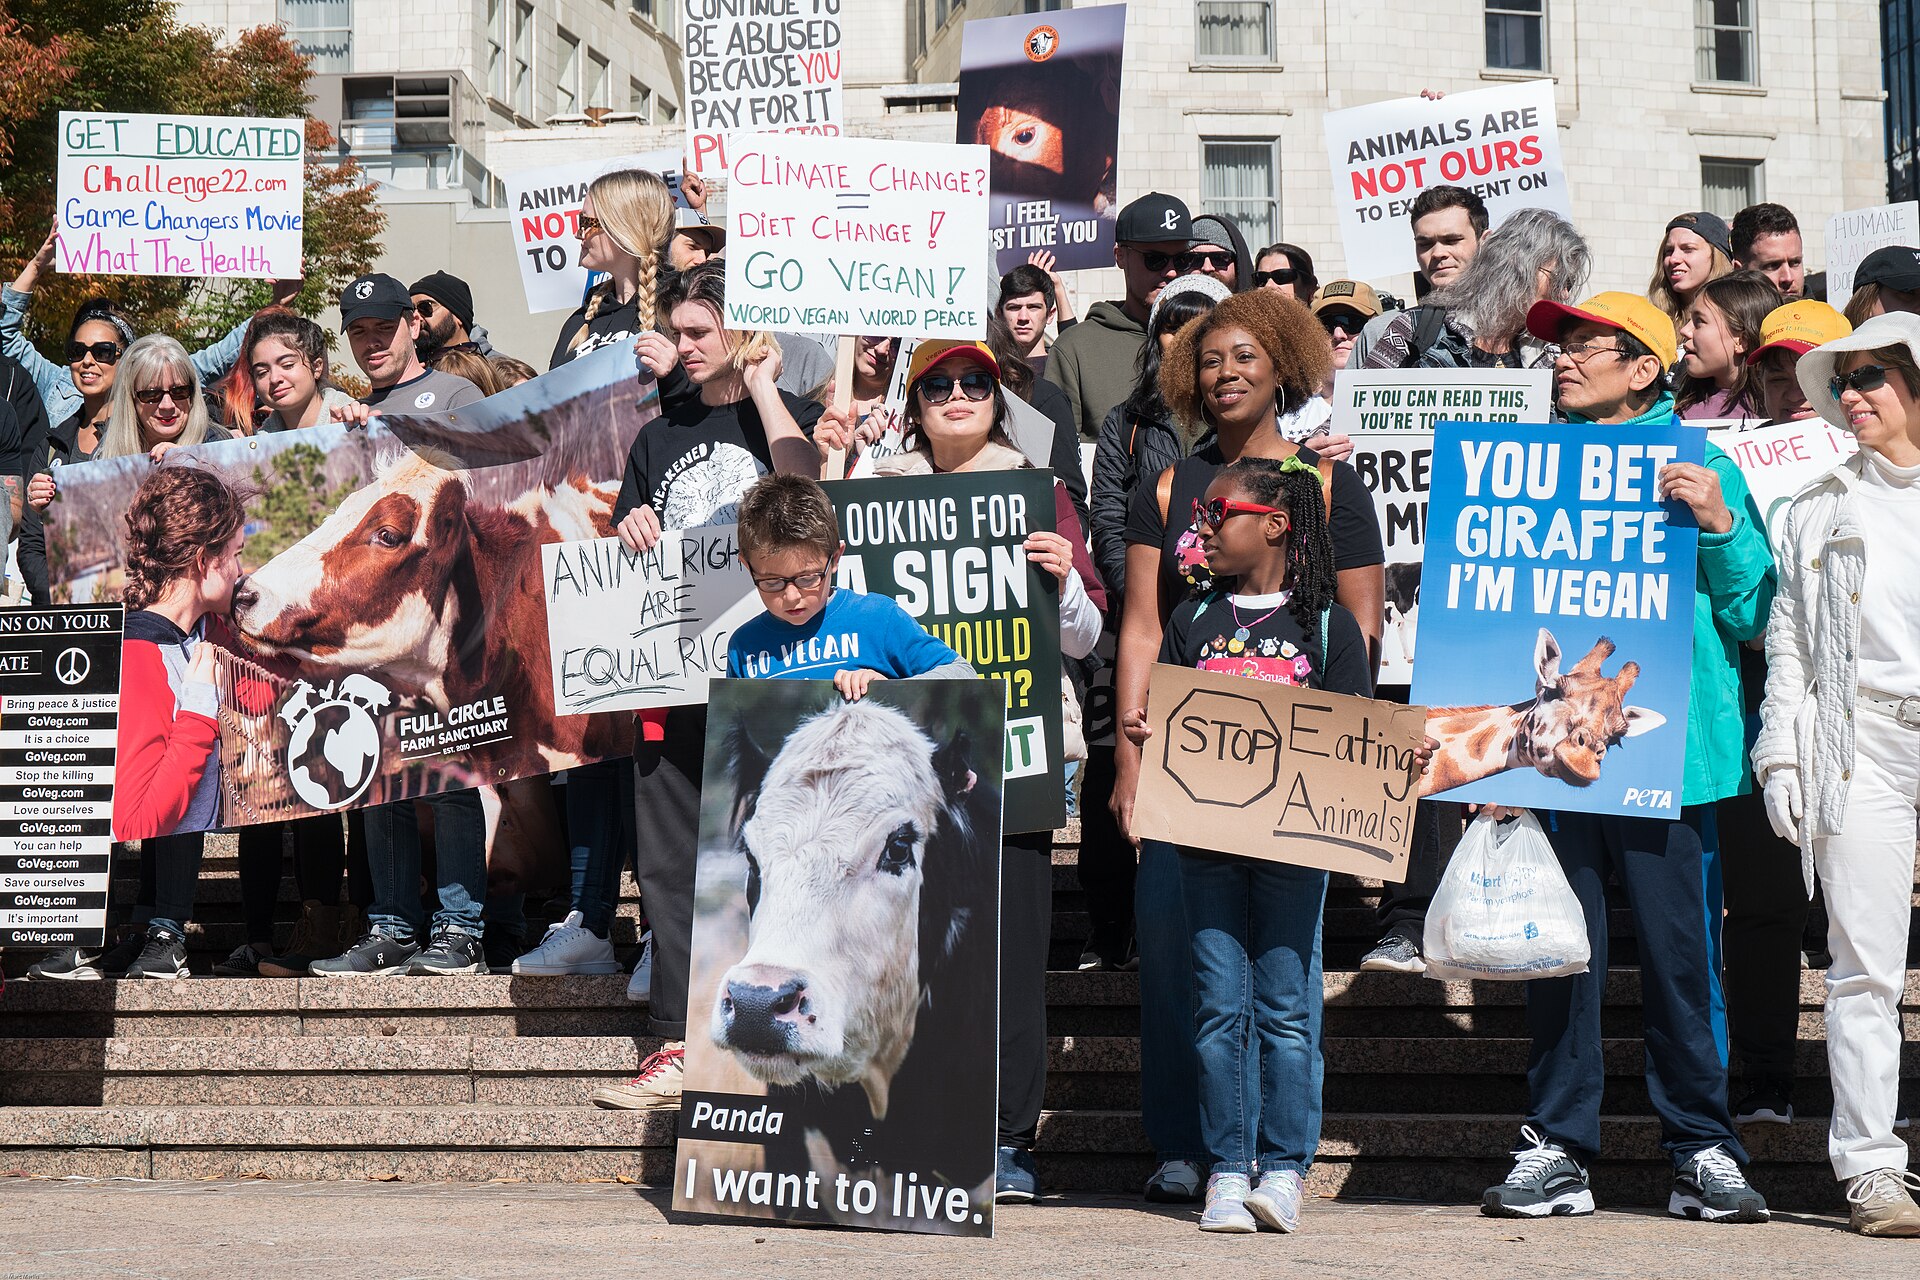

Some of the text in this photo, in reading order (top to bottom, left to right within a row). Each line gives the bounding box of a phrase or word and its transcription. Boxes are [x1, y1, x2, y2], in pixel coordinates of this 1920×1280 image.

[686, 20, 841, 57] BE ABUSED
[689, 50, 841, 95] BECAUSE YOU
[692, 88, 832, 129] PAY FOR IT
[66, 118, 301, 156] GET EDUCATED
[1348, 107, 1538, 164] ANIMALS ARE
[84, 165, 286, 202] Challenge22.com
[870, 164, 986, 196] CHANGE?
[1351, 136, 1542, 200] NOT OURS
[519, 183, 589, 211] ANIMA
[1007, 200, 1060, 224] I FEEL,
[1356, 205, 1382, 223] TO
[1518, 172, 1548, 191] ON
[65, 198, 302, 241] Game Changers Movie
[989, 220, 1097, 250] ST LIKE YOU
[1835, 209, 1905, 239] HUMANE
[56, 233, 274, 275] What The Health
[527, 245, 566, 273] TO
[745, 251, 803, 292] GO
[1834, 271, 1853, 291] DOE
[729, 303, 978, 330] WORLD VEGAN WORLD PEACE
[1353, 390, 1528, 410] IF YOU CAN READ THIS,
[1360, 412, 1413, 429] YOU'RE
[1460, 441, 1677, 503] YOU BET
[833, 494, 1027, 547] OOKING FOR
[1455, 505, 1670, 564] GIRAFFE
[551, 534, 743, 603] ANIMAL RIGH
[893, 544, 1028, 618] SIGN
[641, 584, 697, 626] ARE
[1447, 563, 1669, 620] I'M VEGAN
[26, 616, 53, 631] ON
[62, 614, 110, 629] YOUR
[562, 631, 727, 697] EQUAL RIG
[746, 633, 859, 678] GO VEGAN
[7, 698, 117, 710] Bring peace & justice
[401, 696, 507, 736] FULL CIRCLE
[25, 734, 32, 743] It
[35, 734, 42, 743] is
[56, 733, 90, 743] choice
[28, 716, 88, 728] GoVeg.com
[401, 718, 508, 752] FARM SANCTUARY
[1180, 716, 1280, 764] STOP
[1289, 703, 1415, 801] Eating
[25, 751, 86, 763] GoVeg.com
[16, 770, 94, 782] Stop the killing
[14, 804, 93, 815] Love ourselves
[23, 788, 84, 800] GoVeg.com
[20, 822, 82, 835] GoVeg.com
[1278, 771, 1411, 857] Animals!
[14, 840, 82, 852] You can help
[17, 858, 79, 870] GoVeg.com
[4, 877, 85, 887] Save ourselves
[14, 895, 77, 907] GoVeg.com
[8, 913, 78, 925] It's important
[12, 931, 74, 943] GoVeg.com
[692, 1102, 784, 1135] Panda
[685, 1159, 983, 1225] I want to live.
